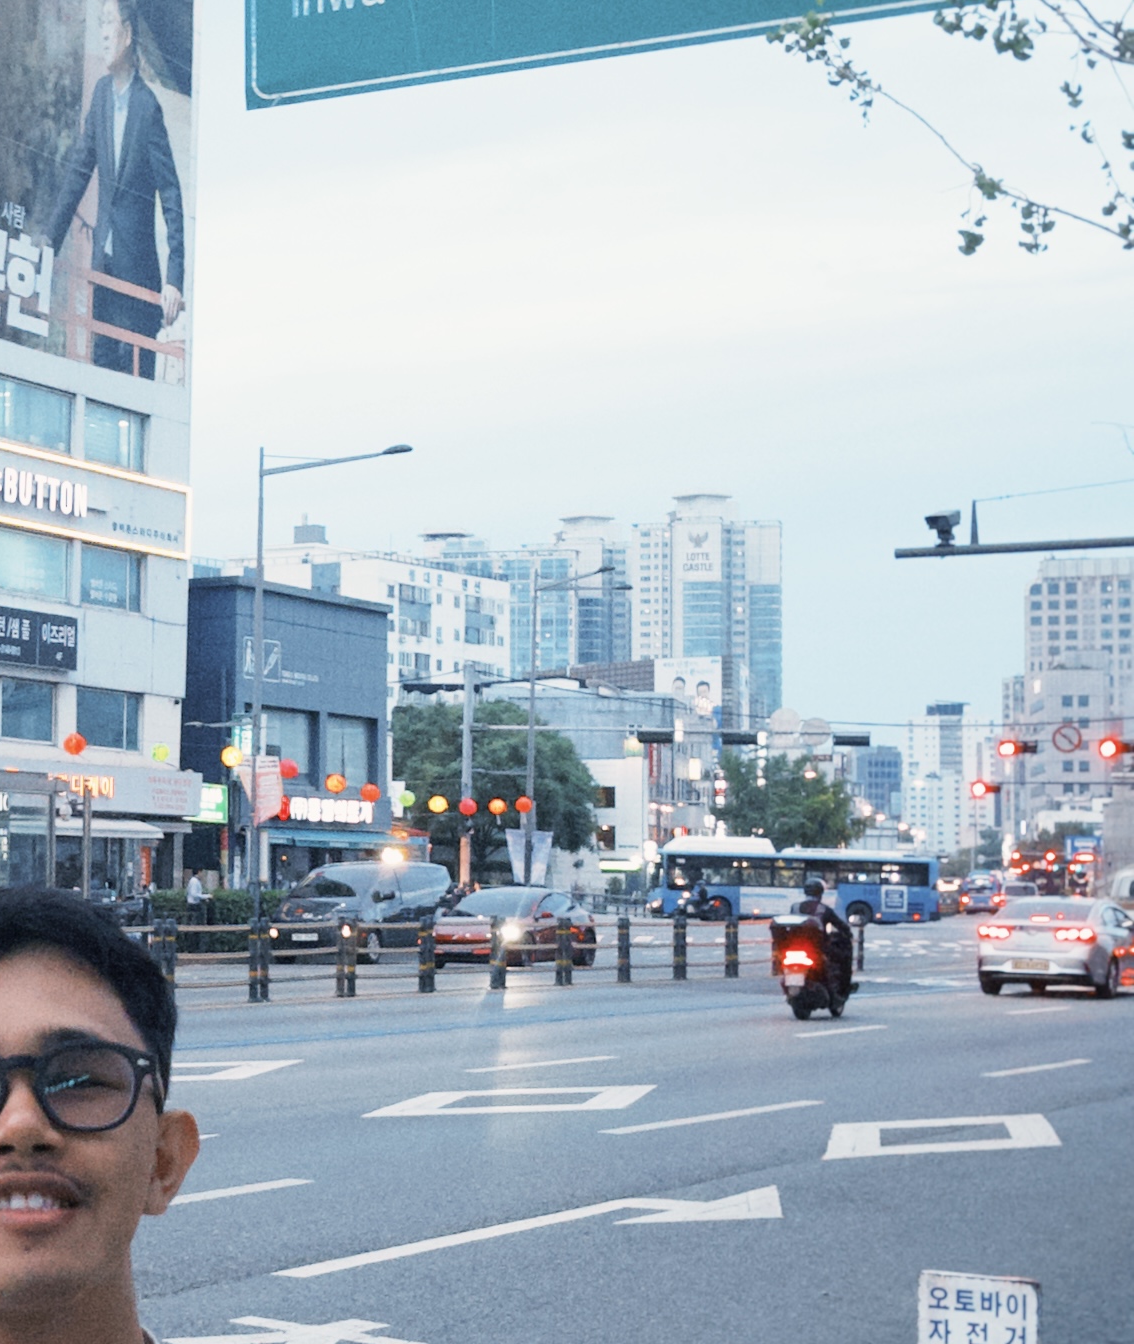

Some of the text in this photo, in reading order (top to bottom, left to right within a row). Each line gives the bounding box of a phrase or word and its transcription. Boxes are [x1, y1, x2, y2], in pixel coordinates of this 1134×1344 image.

[0, 200, 27, 230] 사람
[686, 552, 711, 562] LOTTE
[682, 562, 714, 573] CASTLE
[928, 1285, 1028, 1321] 오토바이
